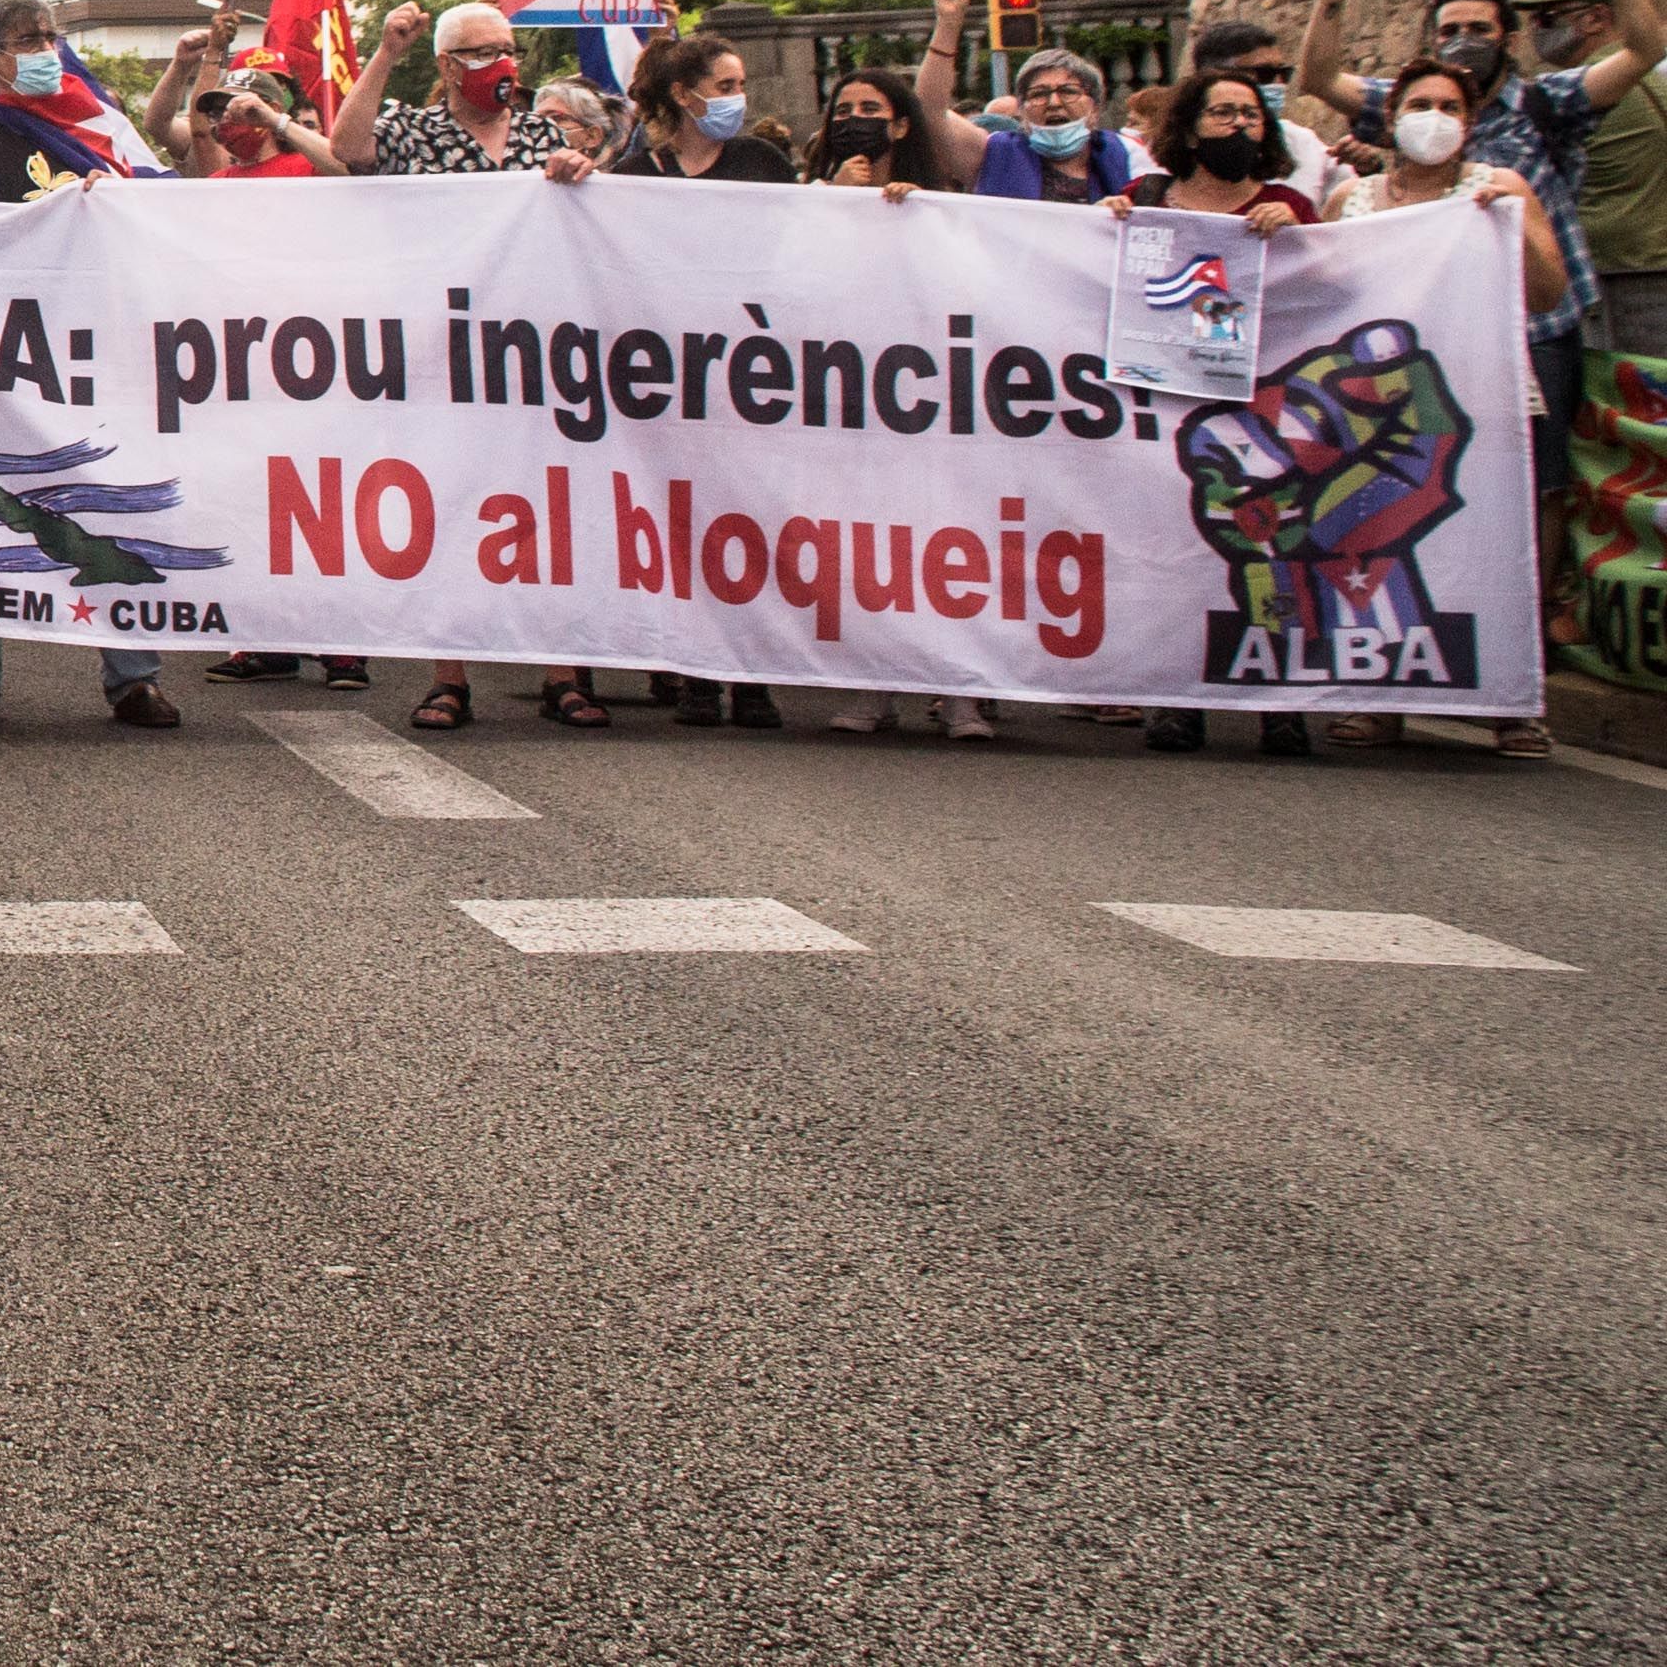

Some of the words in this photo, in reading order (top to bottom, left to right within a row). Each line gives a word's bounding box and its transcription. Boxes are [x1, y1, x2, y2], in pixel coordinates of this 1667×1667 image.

[153, 315, 407, 434] prou
[267, 455, 436, 582] NO
[477, 465, 574, 587] al
[611, 469, 1106, 660] bloqueig
[109, 599, 230, 634] CUBA
[1227, 625, 1452, 683] ALBA
